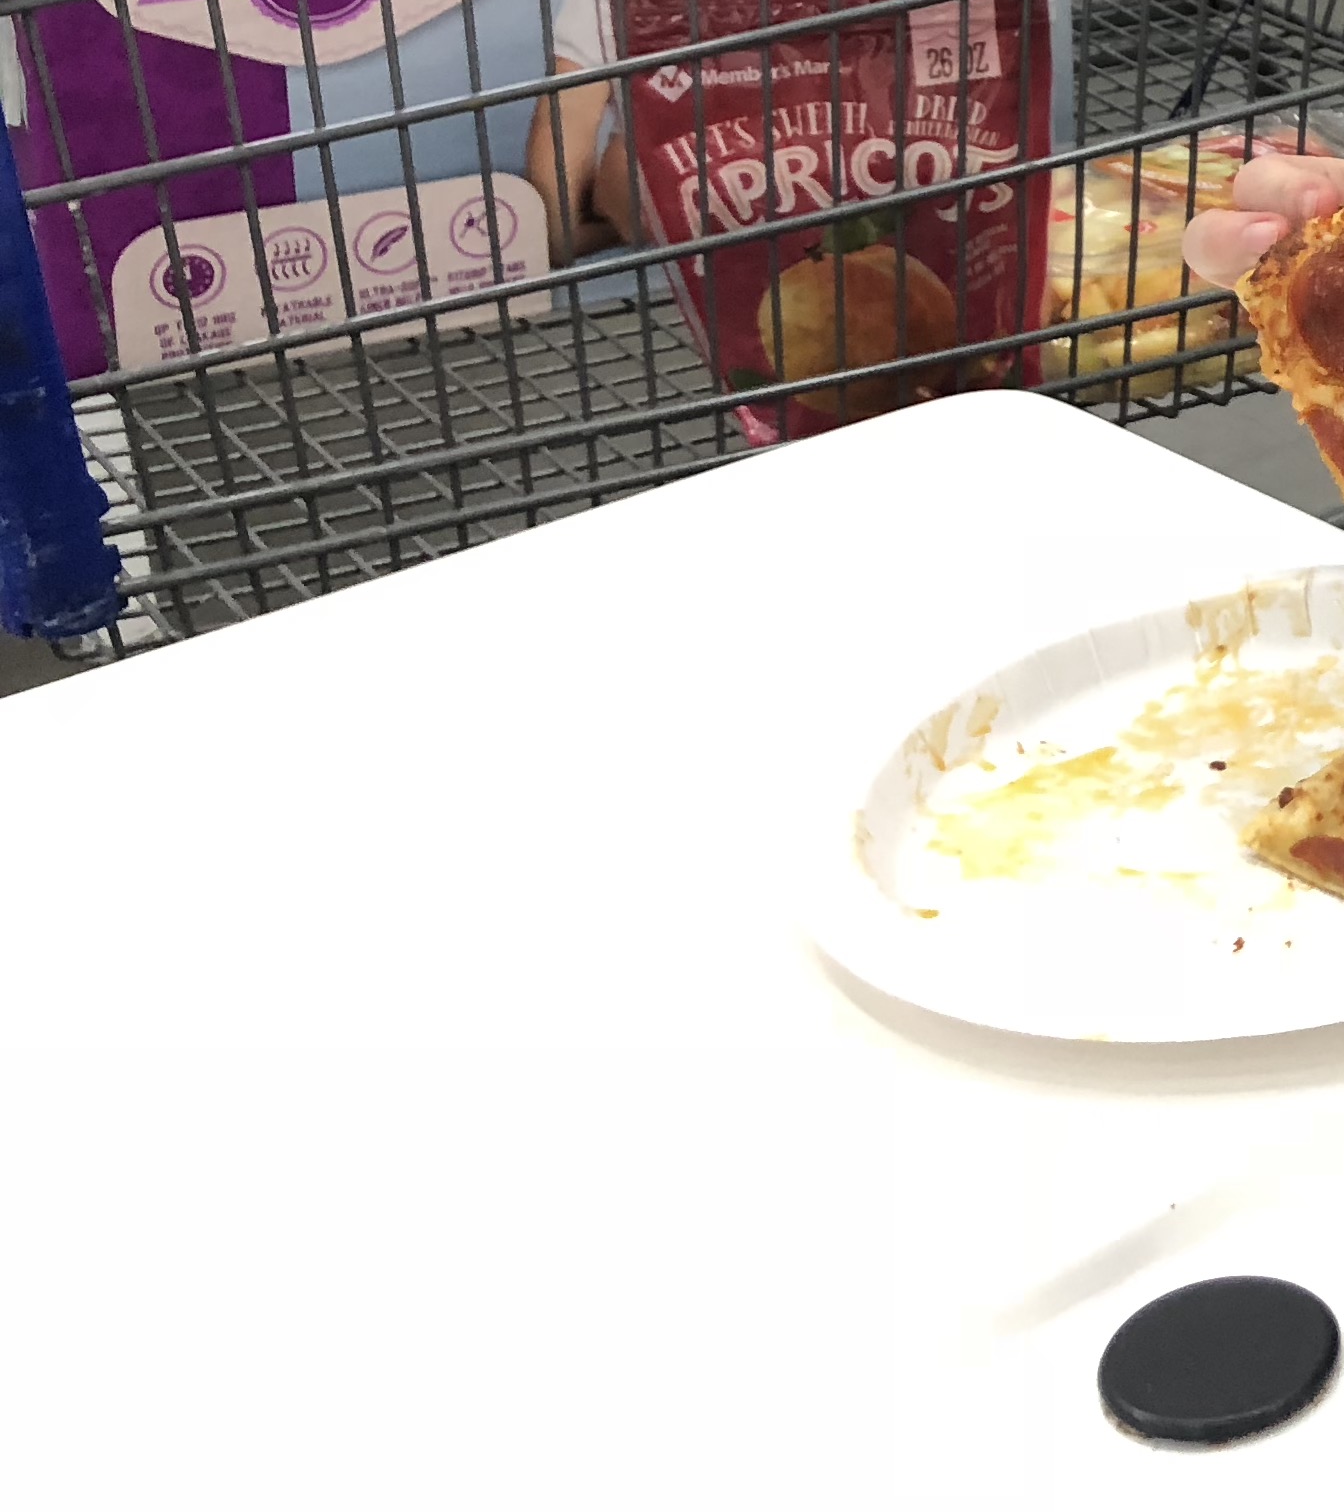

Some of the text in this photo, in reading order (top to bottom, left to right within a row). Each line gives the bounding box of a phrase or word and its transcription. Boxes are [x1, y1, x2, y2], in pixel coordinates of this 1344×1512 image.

[701, 64, 791, 86] Membr's
[794, 59, 840, 76] Mar
[926, 46, 954, 80] 26
[915, 94, 988, 126] DRID
[680, 138, 1019, 277] APRICOTS
